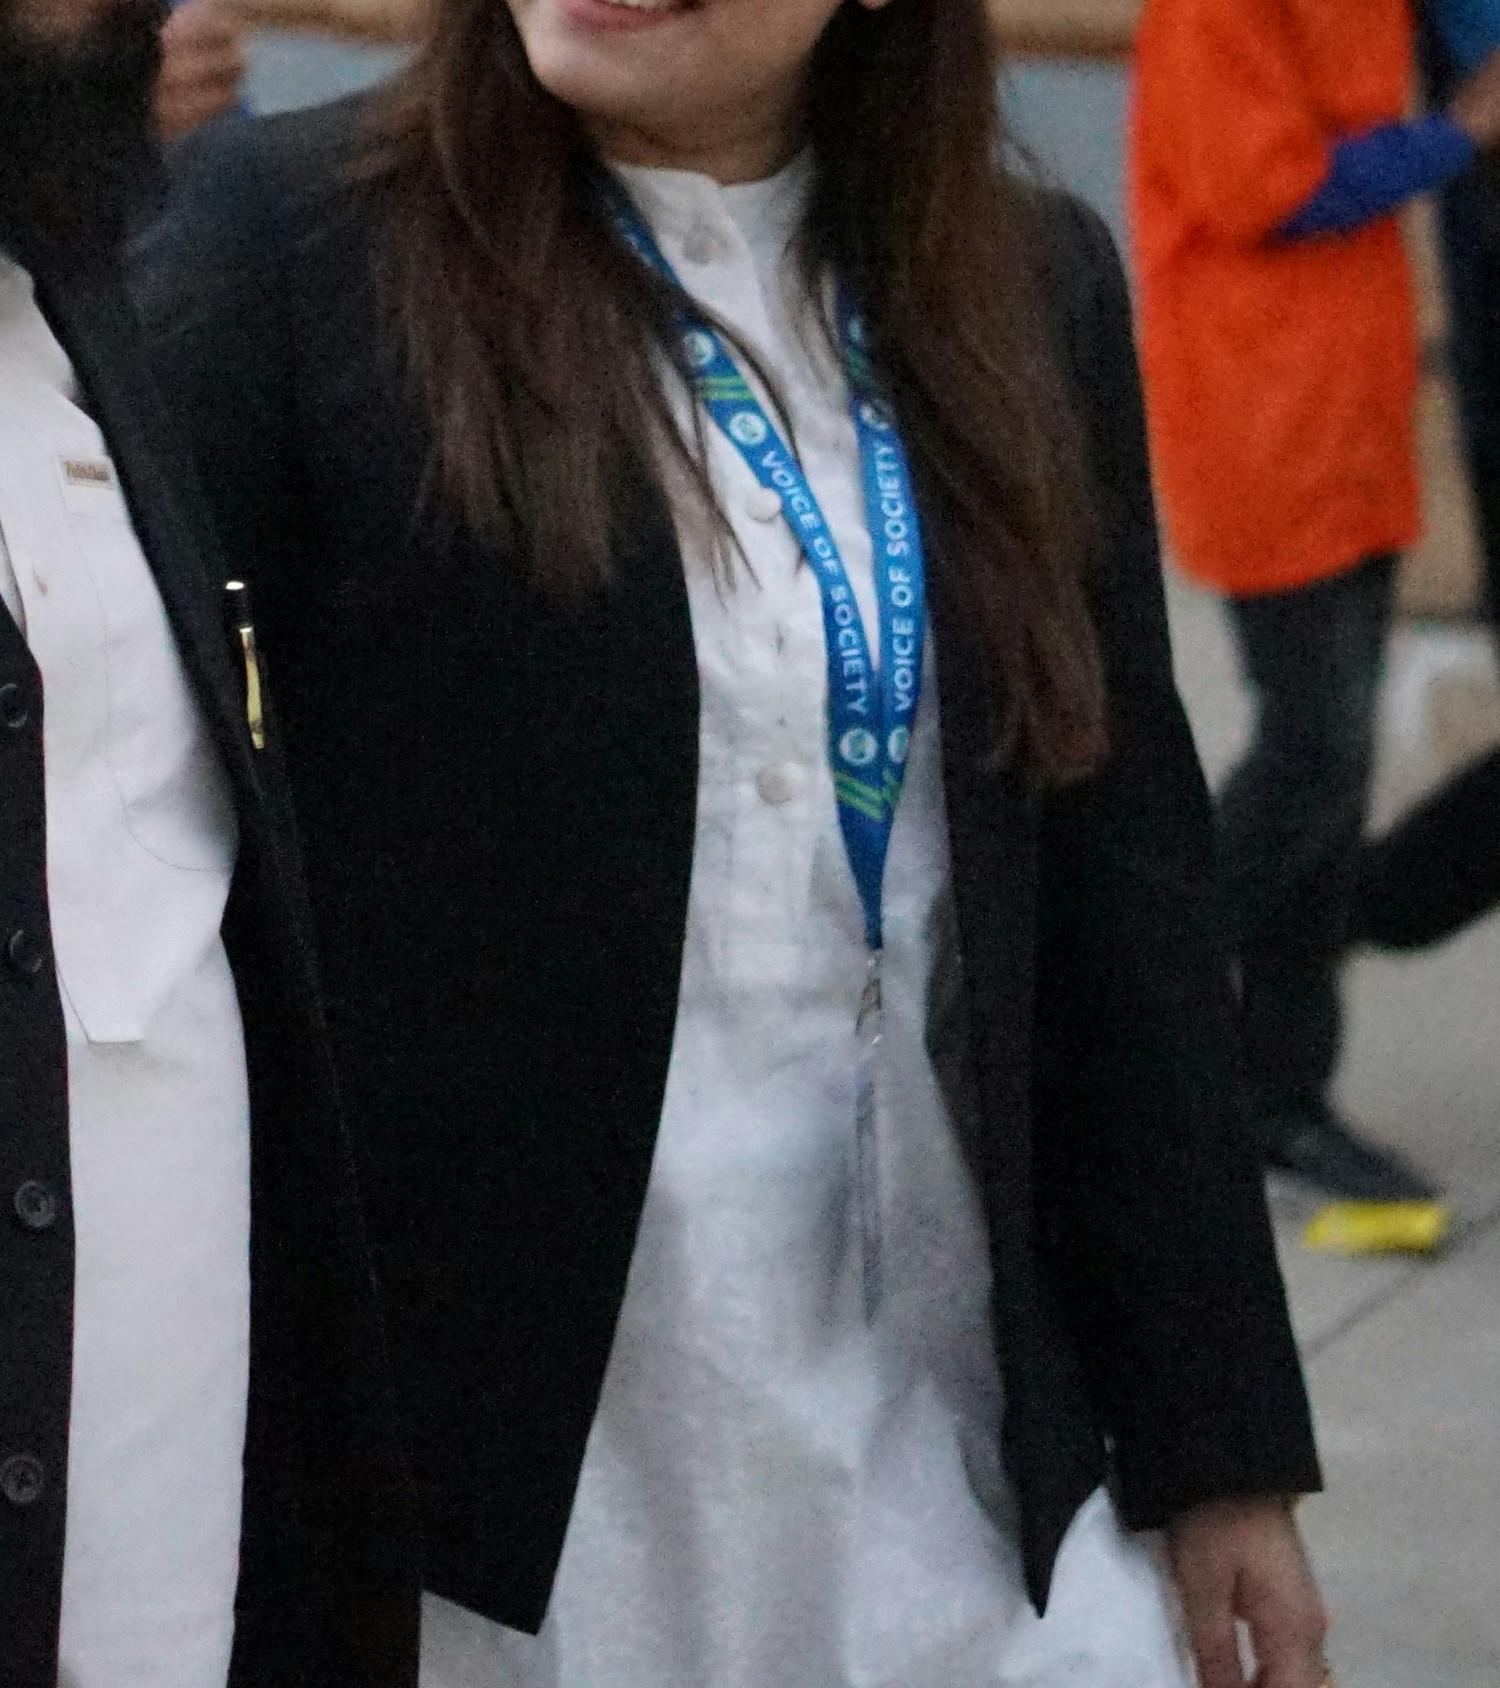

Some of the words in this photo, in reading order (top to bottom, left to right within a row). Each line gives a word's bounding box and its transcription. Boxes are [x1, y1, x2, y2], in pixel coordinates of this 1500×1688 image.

[873, 441, 909, 557] SOCIETY
[761, 450, 822, 530] VOICE
[813, 536, 841, 576] OF
[829, 585, 869, 714] SOCIETY
[888, 566, 914, 609] OF
[892, 615, 915, 712] VOICE
